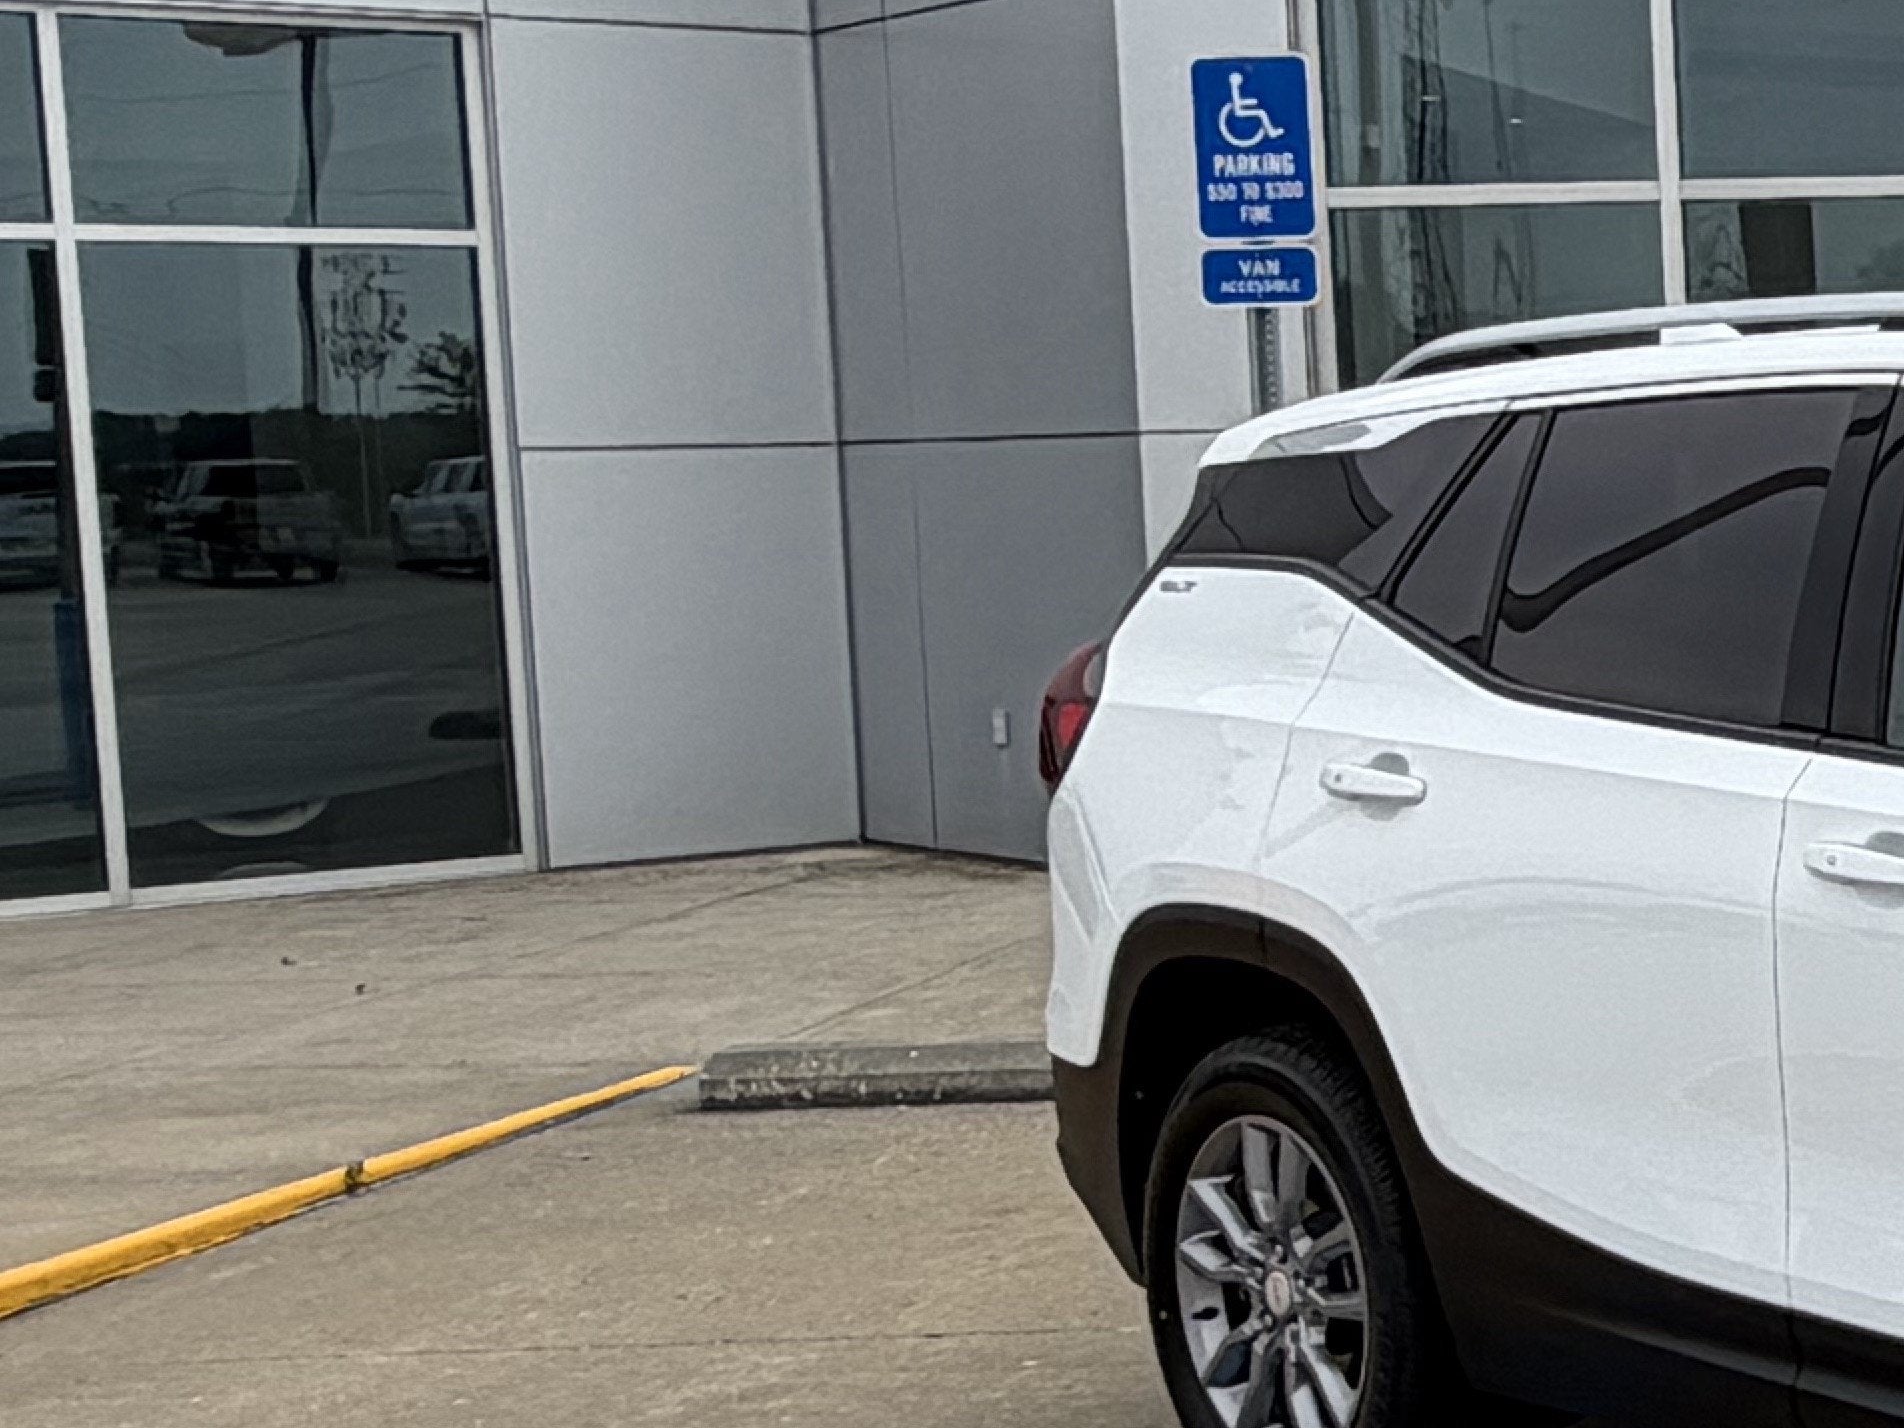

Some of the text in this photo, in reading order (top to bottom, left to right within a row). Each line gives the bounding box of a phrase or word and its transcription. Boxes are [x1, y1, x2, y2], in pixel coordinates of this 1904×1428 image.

[1212, 152, 1296, 178] PARKING
[1242, 182, 1261, 201] TO
[1239, 204, 1274, 224] FINE
[1238, 258, 1281, 278] VAN
